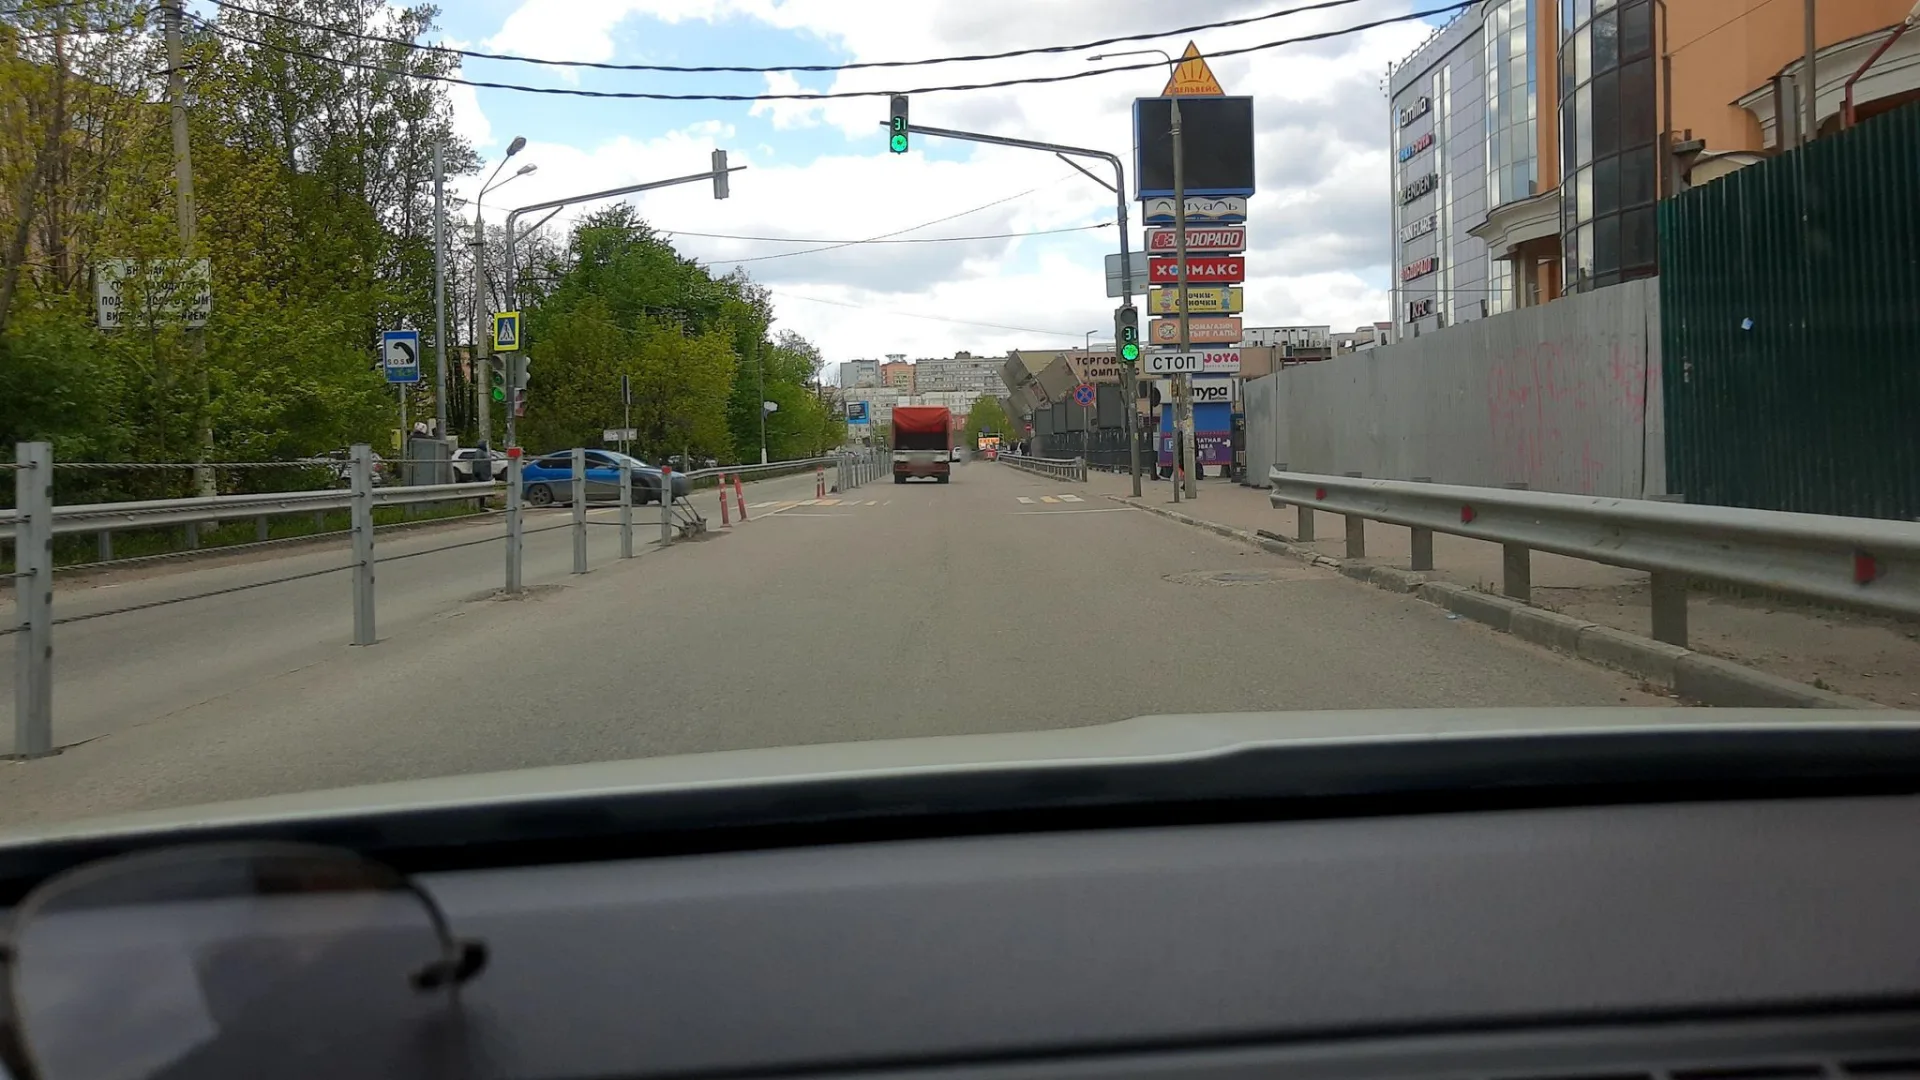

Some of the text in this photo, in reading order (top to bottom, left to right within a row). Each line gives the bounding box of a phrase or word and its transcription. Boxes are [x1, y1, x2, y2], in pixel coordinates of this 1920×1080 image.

[894, 117, 906, 131] 31
[1125, 328, 1137, 340] 31
[1076, 356, 1117, 365] ТОРГОВ
[1153, 356, 1196, 370] СТОП
[1084, 368, 1140, 377] КОМПЛС
